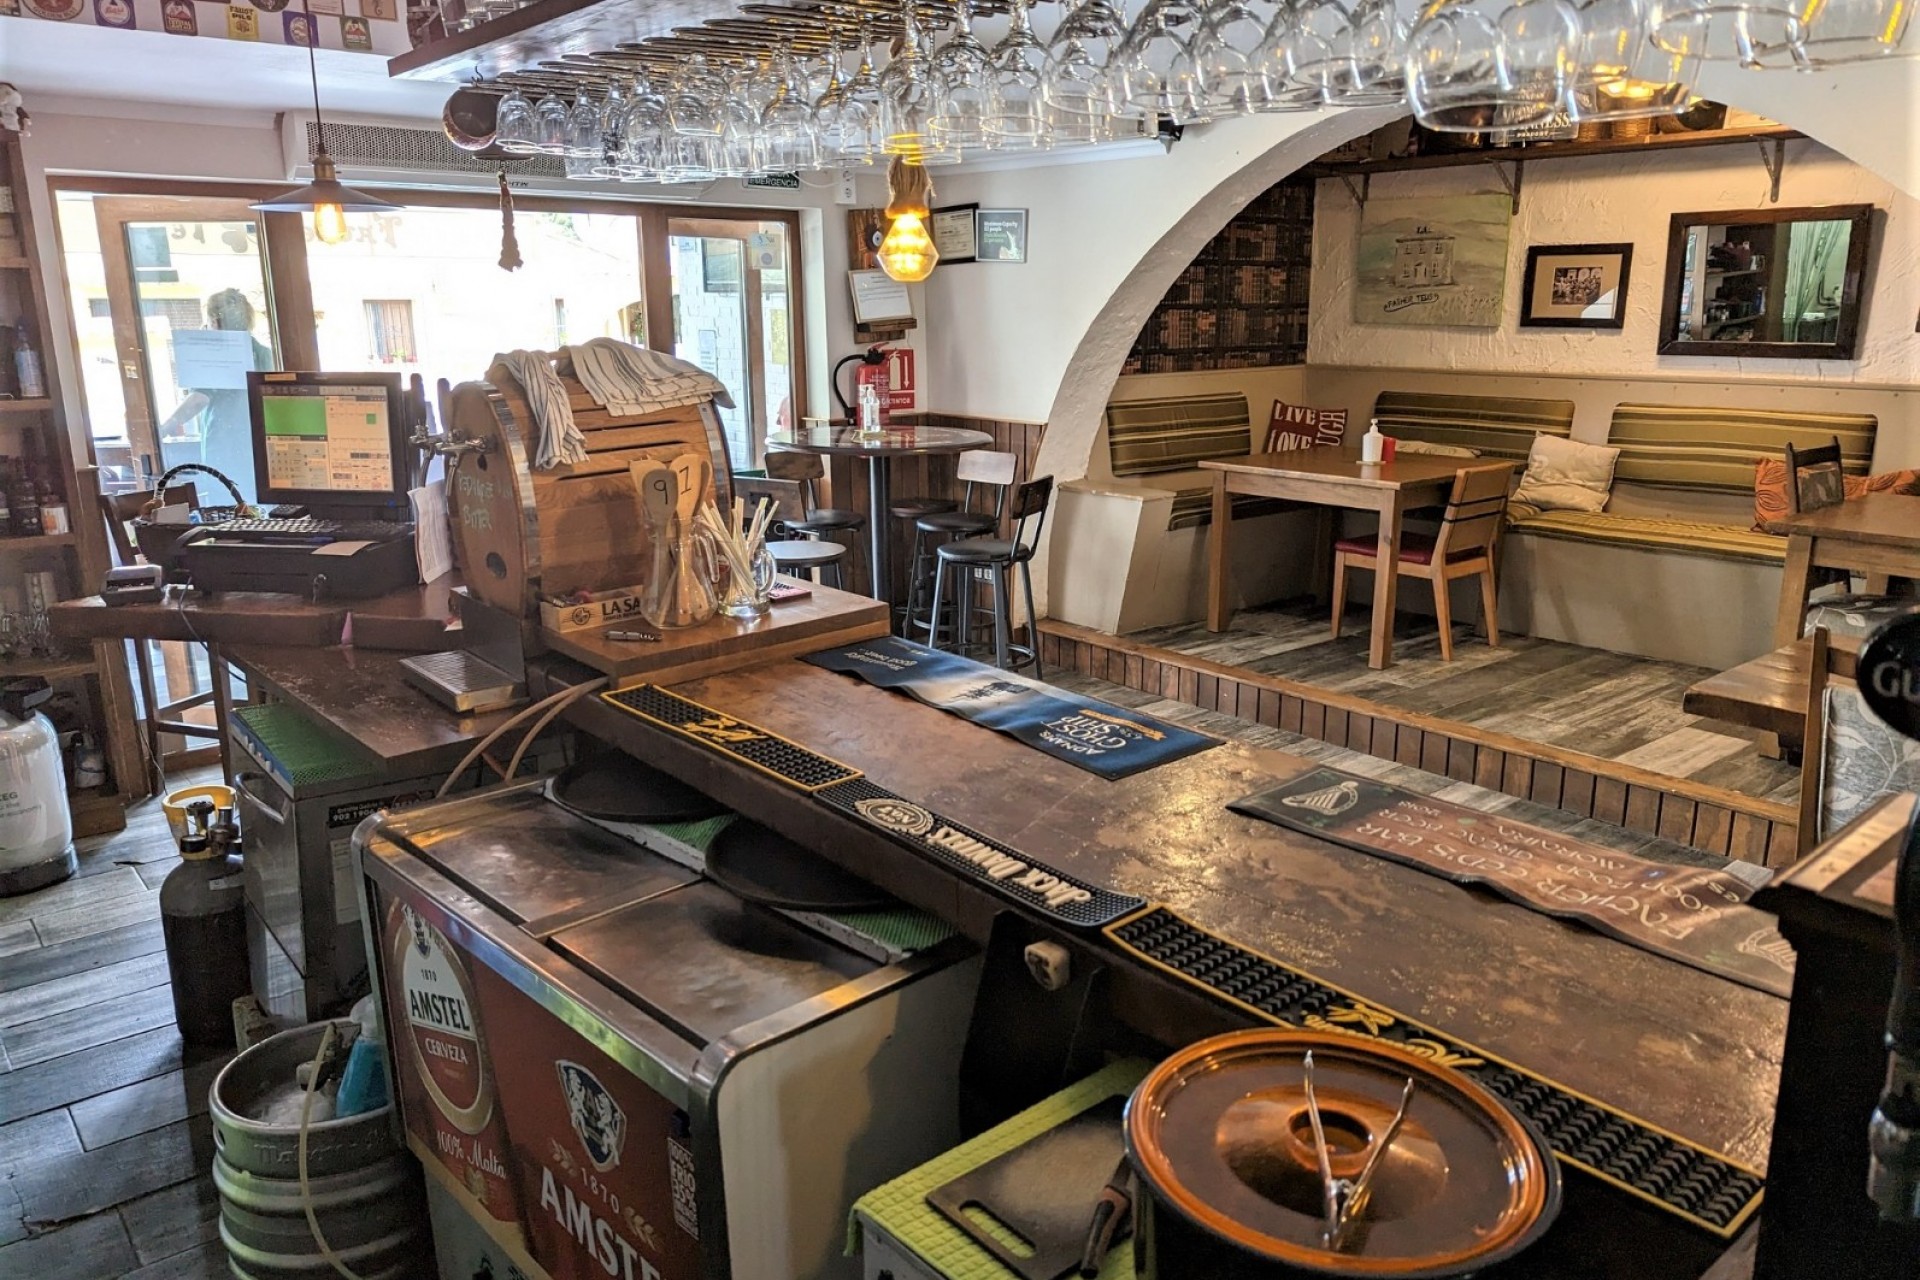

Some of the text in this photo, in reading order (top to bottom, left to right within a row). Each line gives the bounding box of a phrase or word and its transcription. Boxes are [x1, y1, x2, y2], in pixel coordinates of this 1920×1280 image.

[1274, 402, 1317, 426] LIVE
[653, 479, 669, 505] 9
[601, 601, 621, 616] LA
[1041, 720, 1127, 749] GHOST
[1061, 715, 1120, 734] SHIP
[1040, 729, 1106, 755] ADNAMS
[1356, 823, 1423, 846] BAR
[1012, 868, 1092, 909] JACK
[1556, 863, 1634, 889] FOOD
[420, 968, 438, 983] 1870
[408, 988, 471, 1032] AMSTEL
[424, 1037, 469, 1065] CERVEZA
[435, 1129, 507, 1180] 100% Malta
[580, 1167, 620, 1215] 1870
